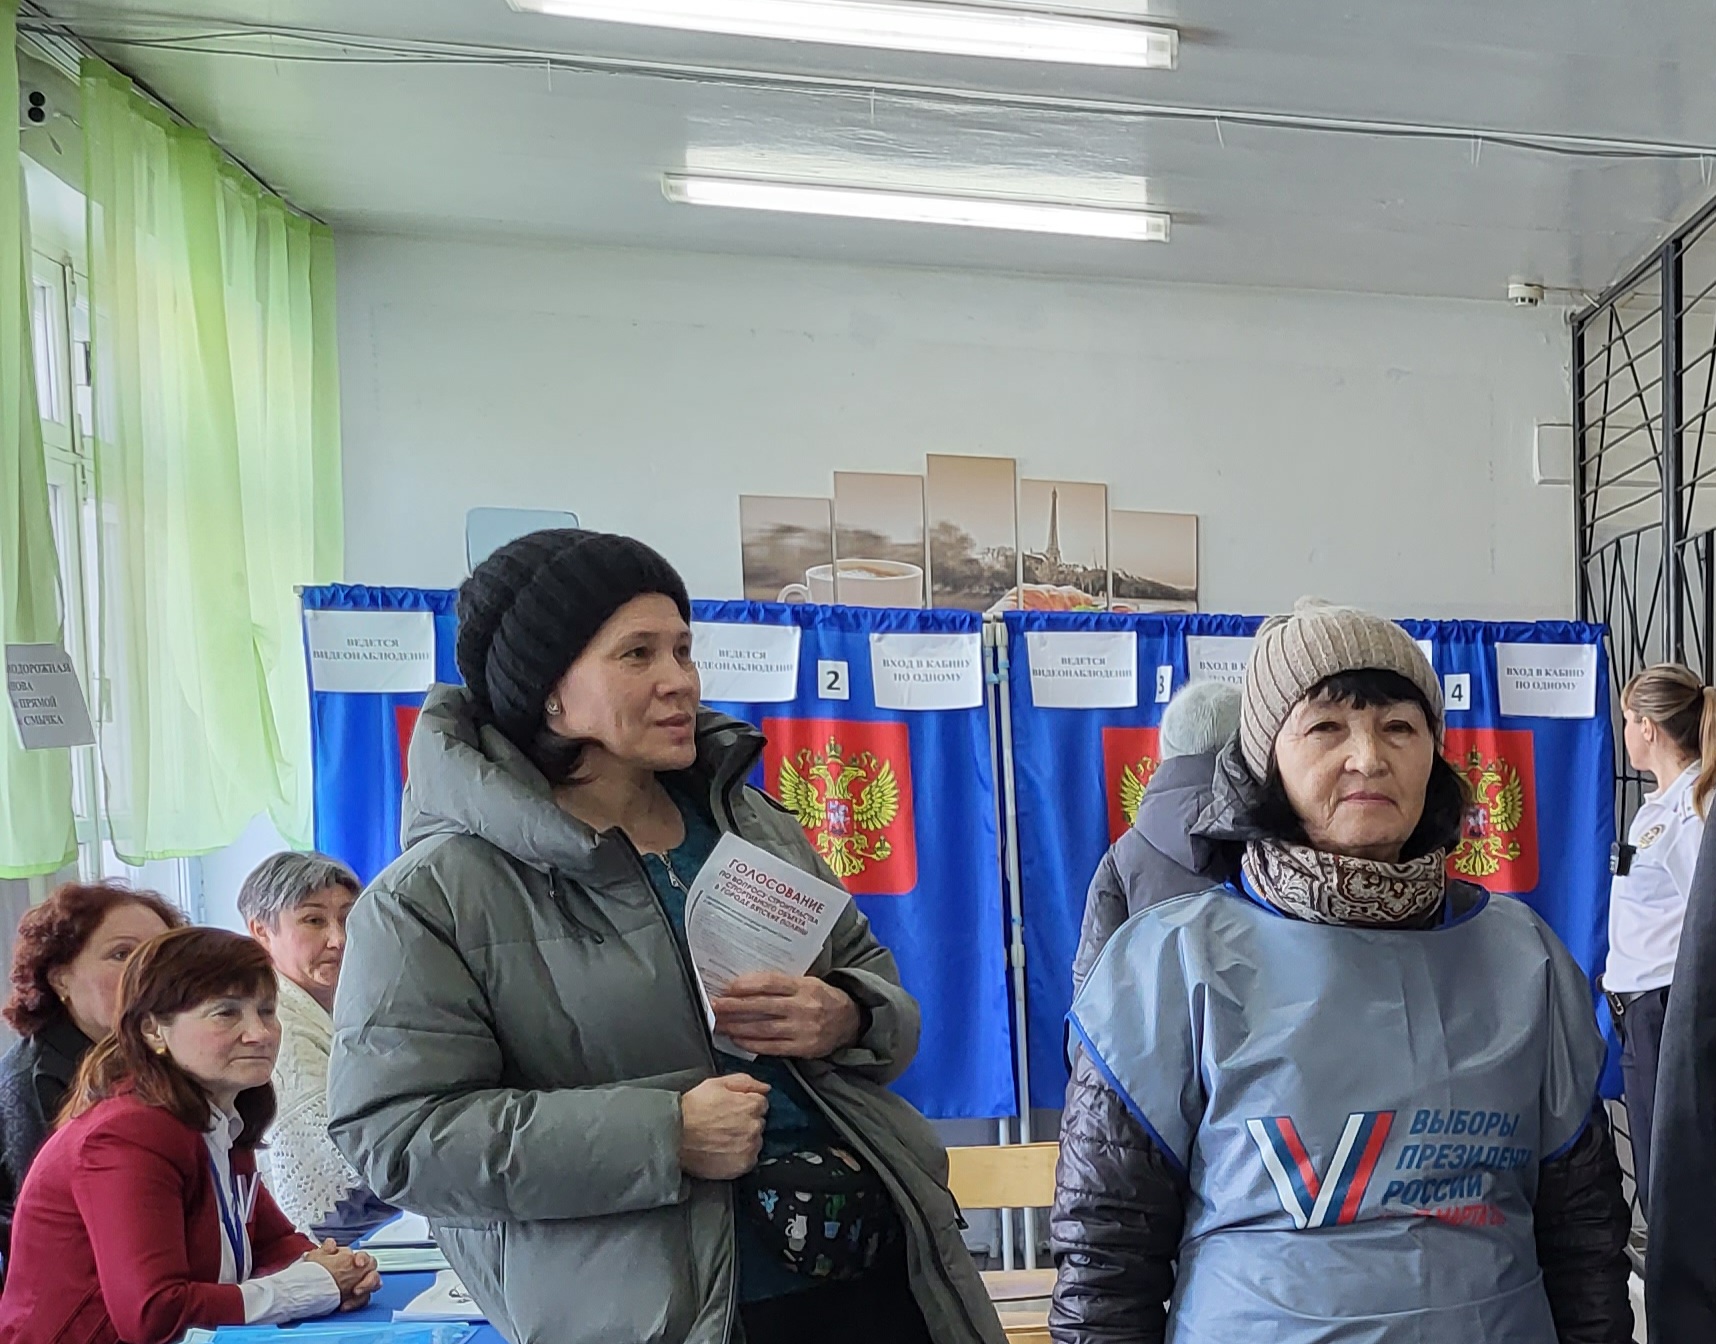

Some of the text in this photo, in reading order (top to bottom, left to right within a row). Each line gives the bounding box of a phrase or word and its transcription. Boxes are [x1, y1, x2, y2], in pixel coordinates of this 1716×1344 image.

[346, 638, 400, 649] ВЕДЕТСЯ
[718, 649, 767, 660] ВЕДЕТСЯ
[882, 658, 971, 669] ВХОД В КАБИНУ
[1060, 657, 1106, 666] ВЕДЕТСЯ
[1199, 660, 1228, 671] ВХОД
[893, 672, 961, 683] ПО ОДНОМУ
[1506, 667, 1585, 678] ВХОД В КАБИНУ
[826, 670, 841, 691] 2
[1158, 675, 1165, 695] 3
[1515, 680, 1577, 691] ПО ОДНОМУ
[1450, 683, 1463, 702] 4
[718, 869, 732, 879] ПО
[731, 875, 766, 898] ВОПРОСУ
[728, 858, 825, 914] ГОЛОСОВАНИЕ
[1409, 1108, 1521, 1138] ВЫБОРЫ
[1381, 1173, 1483, 1206] РОССИИ
